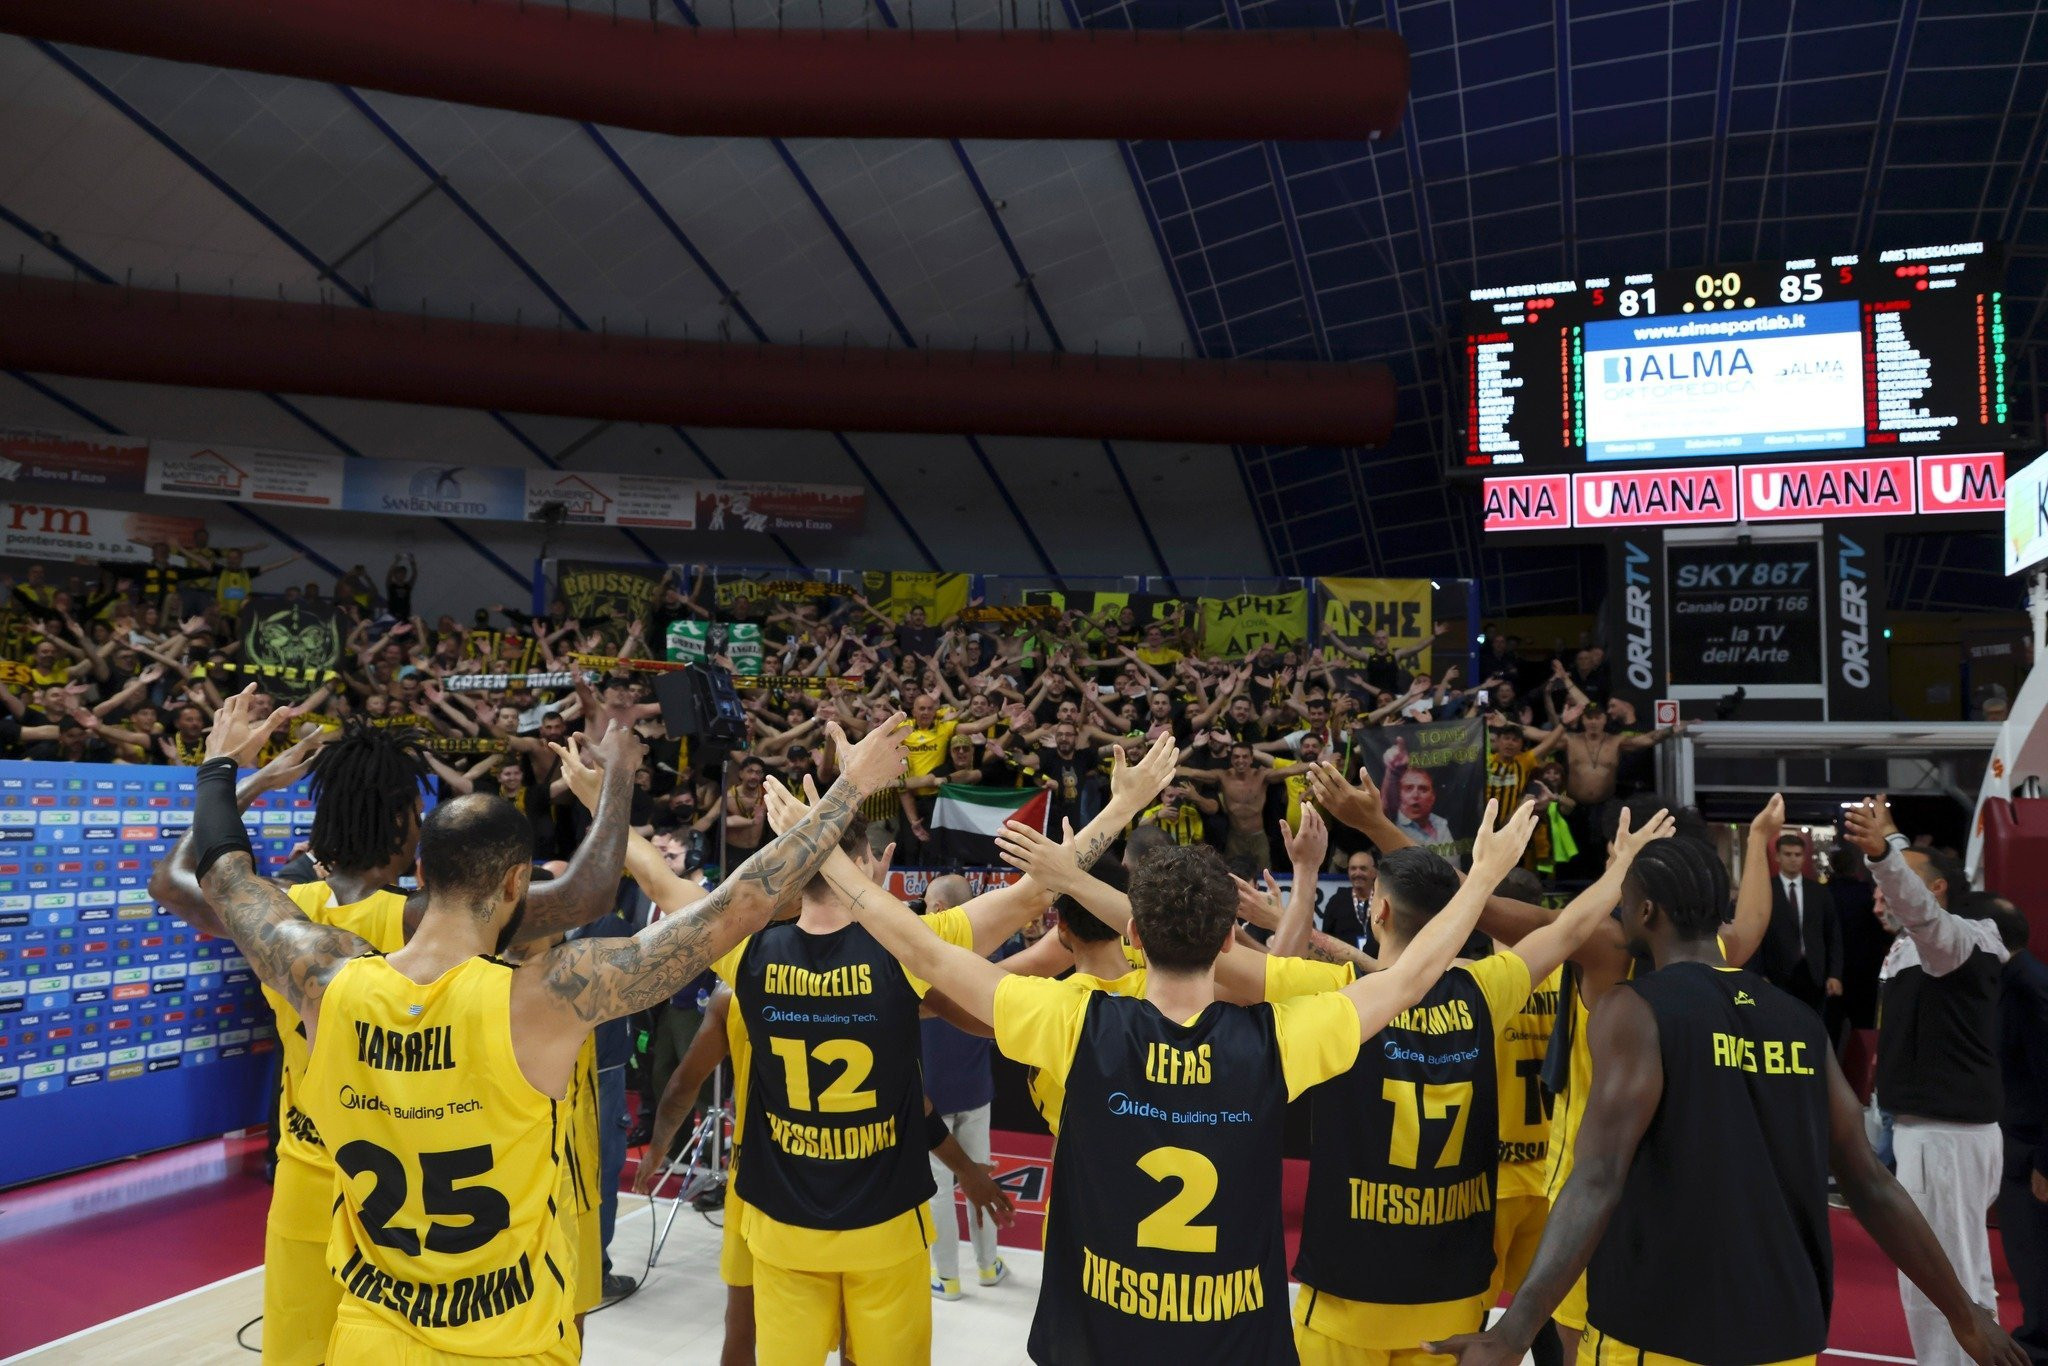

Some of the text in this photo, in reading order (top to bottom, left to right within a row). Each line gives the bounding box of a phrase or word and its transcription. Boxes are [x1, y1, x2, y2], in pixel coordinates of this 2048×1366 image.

[1880, 242, 1983, 263] ARIS THESSALONIKI
[1695, 271, 1741, 298] 0:0
[1779, 273, 1824, 303] 85
[1839, 265, 1853, 284] 5
[1593, 288, 1605, 306] 5
[1618, 288, 1656, 317] 81
[1633, 313, 1806, 341] www.almasportlab.it
[1639, 347, 1755, 383] ALMA
[1790, 360, 1844, 376] ALMA
[1583, 477, 1723, 518] UMANA
[1749, 469, 1903, 512] UMANA
[1930, 463, 2005, 505] UM
[7, 502, 91, 536] rm
[6, 534, 94, 551] ponterosso
[1676, 561, 1810, 588] SKY 867
[1217, 596, 1293, 621] ΑΡΗΣ
[1324, 599, 1422, 638] ΑΡΗΣ
[1676, 596, 1809, 614] Canale DDT 166
[1731, 625, 1749, 643] la
[1756, 624, 1785, 642] TV
[448, 674, 509, 690] GREEN
[97, 781, 114, 790] VISA
[63, 847, 80, 855] VISA
[30, 881, 48, 889] VISA
[120, 877, 136, 885] VISA
[88, 927, 105, 935] VISA
[56, 962, 74, 971] VISA
[764, 963, 873, 997] GKIOUZELIS
[21, 1016, 39, 1025] VISA
[113, 1004, 129, 1013] VISA
[762, 1005, 879, 1025] Midea Building Tech.
[81, 1041, 99, 1050] VISA
[354, 1019, 457, 1073] HARRELL
[1763, 1041, 1815, 1075] B.C.
[769, 1036, 878, 1114] 12
[1145, 1042, 1211, 1085] LEFAS
[393, 1106, 445, 1120] Building
[446, 1098, 484, 1116] Tech.
[1107, 1091, 1253, 1126] Midea Building Tech.
[1382, 1077, 1474, 1170] 17
[335, 1139, 511, 1258] 25
[1135, 1145, 1219, 1253] 2
[1083, 1246, 1264, 1323] THESSALONIKI
